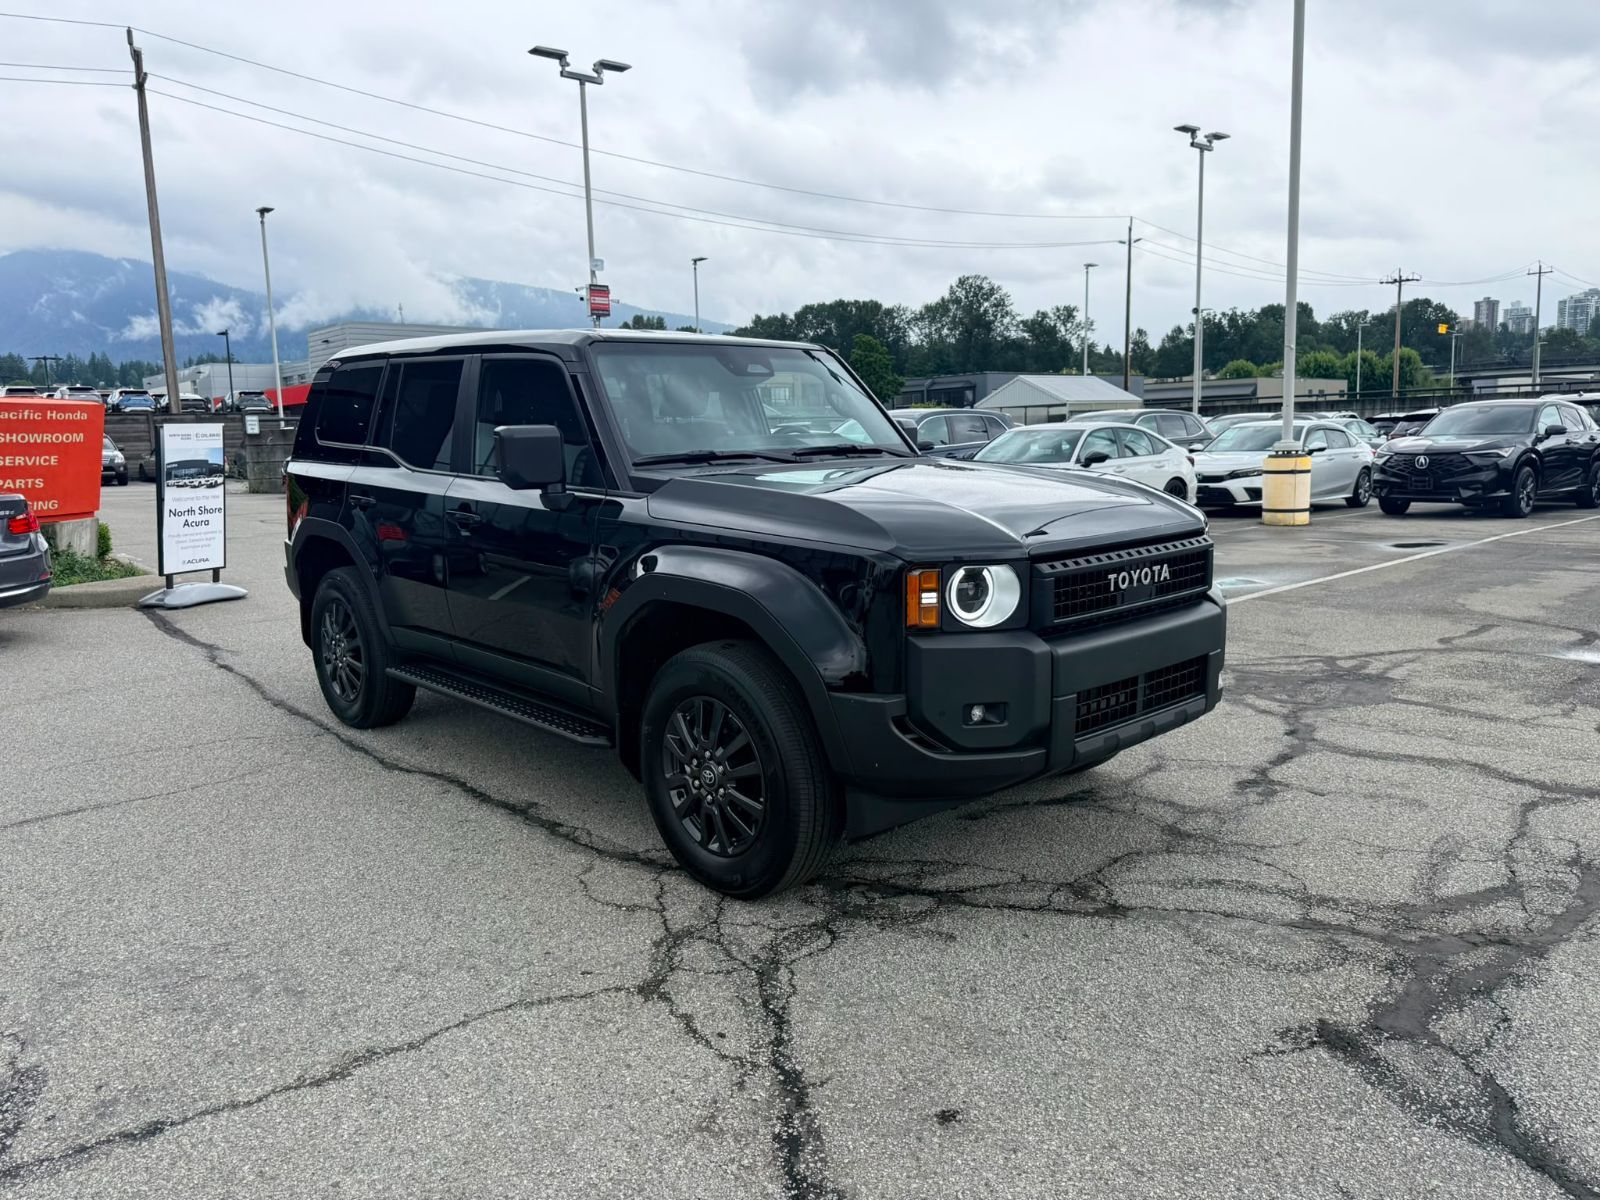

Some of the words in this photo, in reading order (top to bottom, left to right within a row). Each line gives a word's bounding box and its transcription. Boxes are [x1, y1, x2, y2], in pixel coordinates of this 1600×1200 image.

[0, 410, 41, 420] acific
[47, 410, 88, 420] Honda
[0, 432, 84, 443] SHOWROOM
[0, 455, 58, 466] SERVICE
[169, 506, 196, 518] North
[198, 505, 223, 516] Shore
[183, 518, 210, 528] Acura
[186, 557, 210, 565] ACURA
[1107, 563, 1170, 592] TOYOTA
